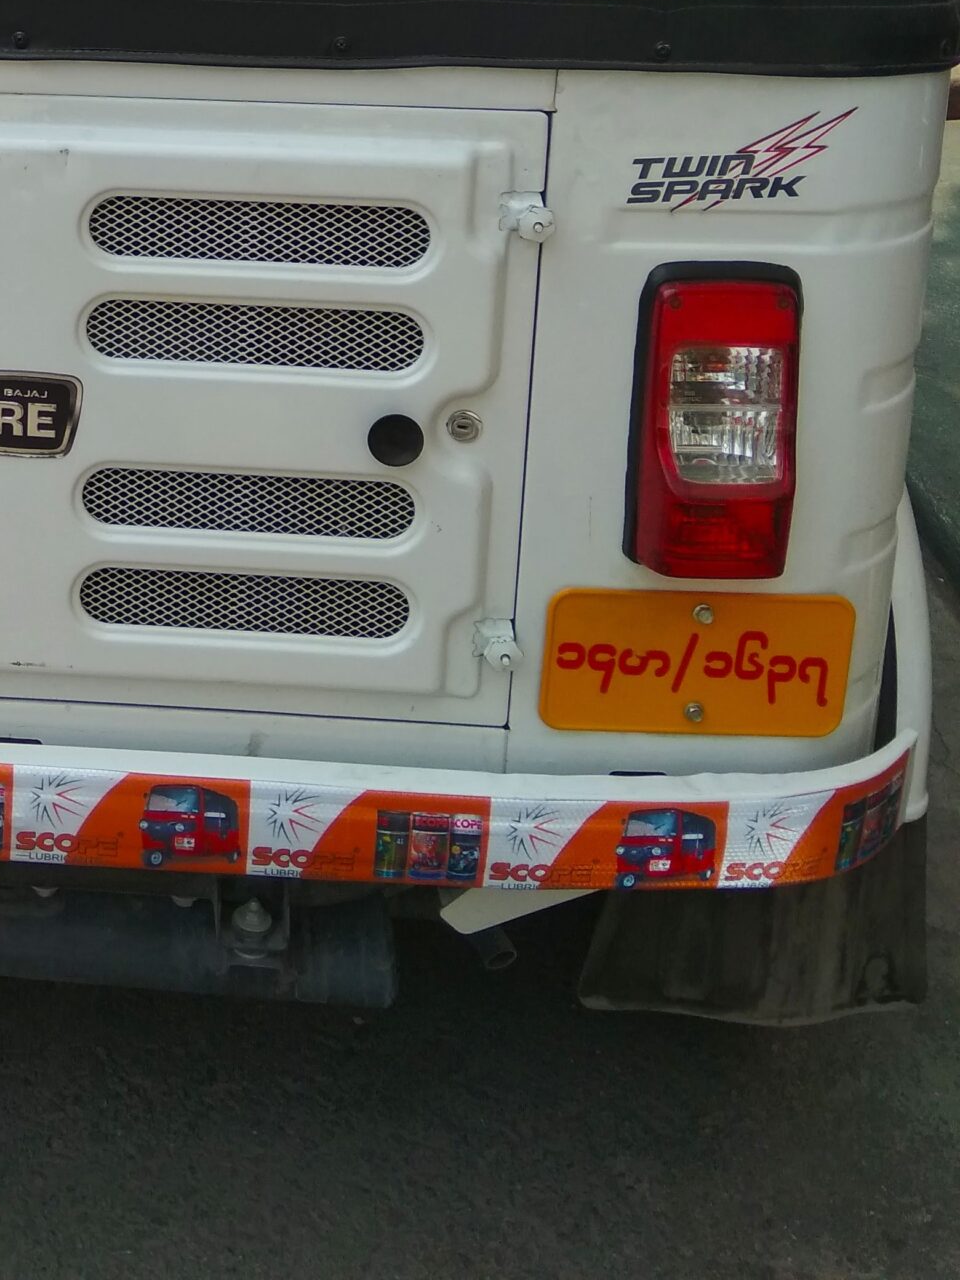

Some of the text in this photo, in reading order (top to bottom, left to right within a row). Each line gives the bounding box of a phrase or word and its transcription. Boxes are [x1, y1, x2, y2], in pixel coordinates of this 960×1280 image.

[632, 153, 756, 179] TWIN
[626, 175, 807, 204] SPARK
[3, 388, 48, 399] BAJAJ
